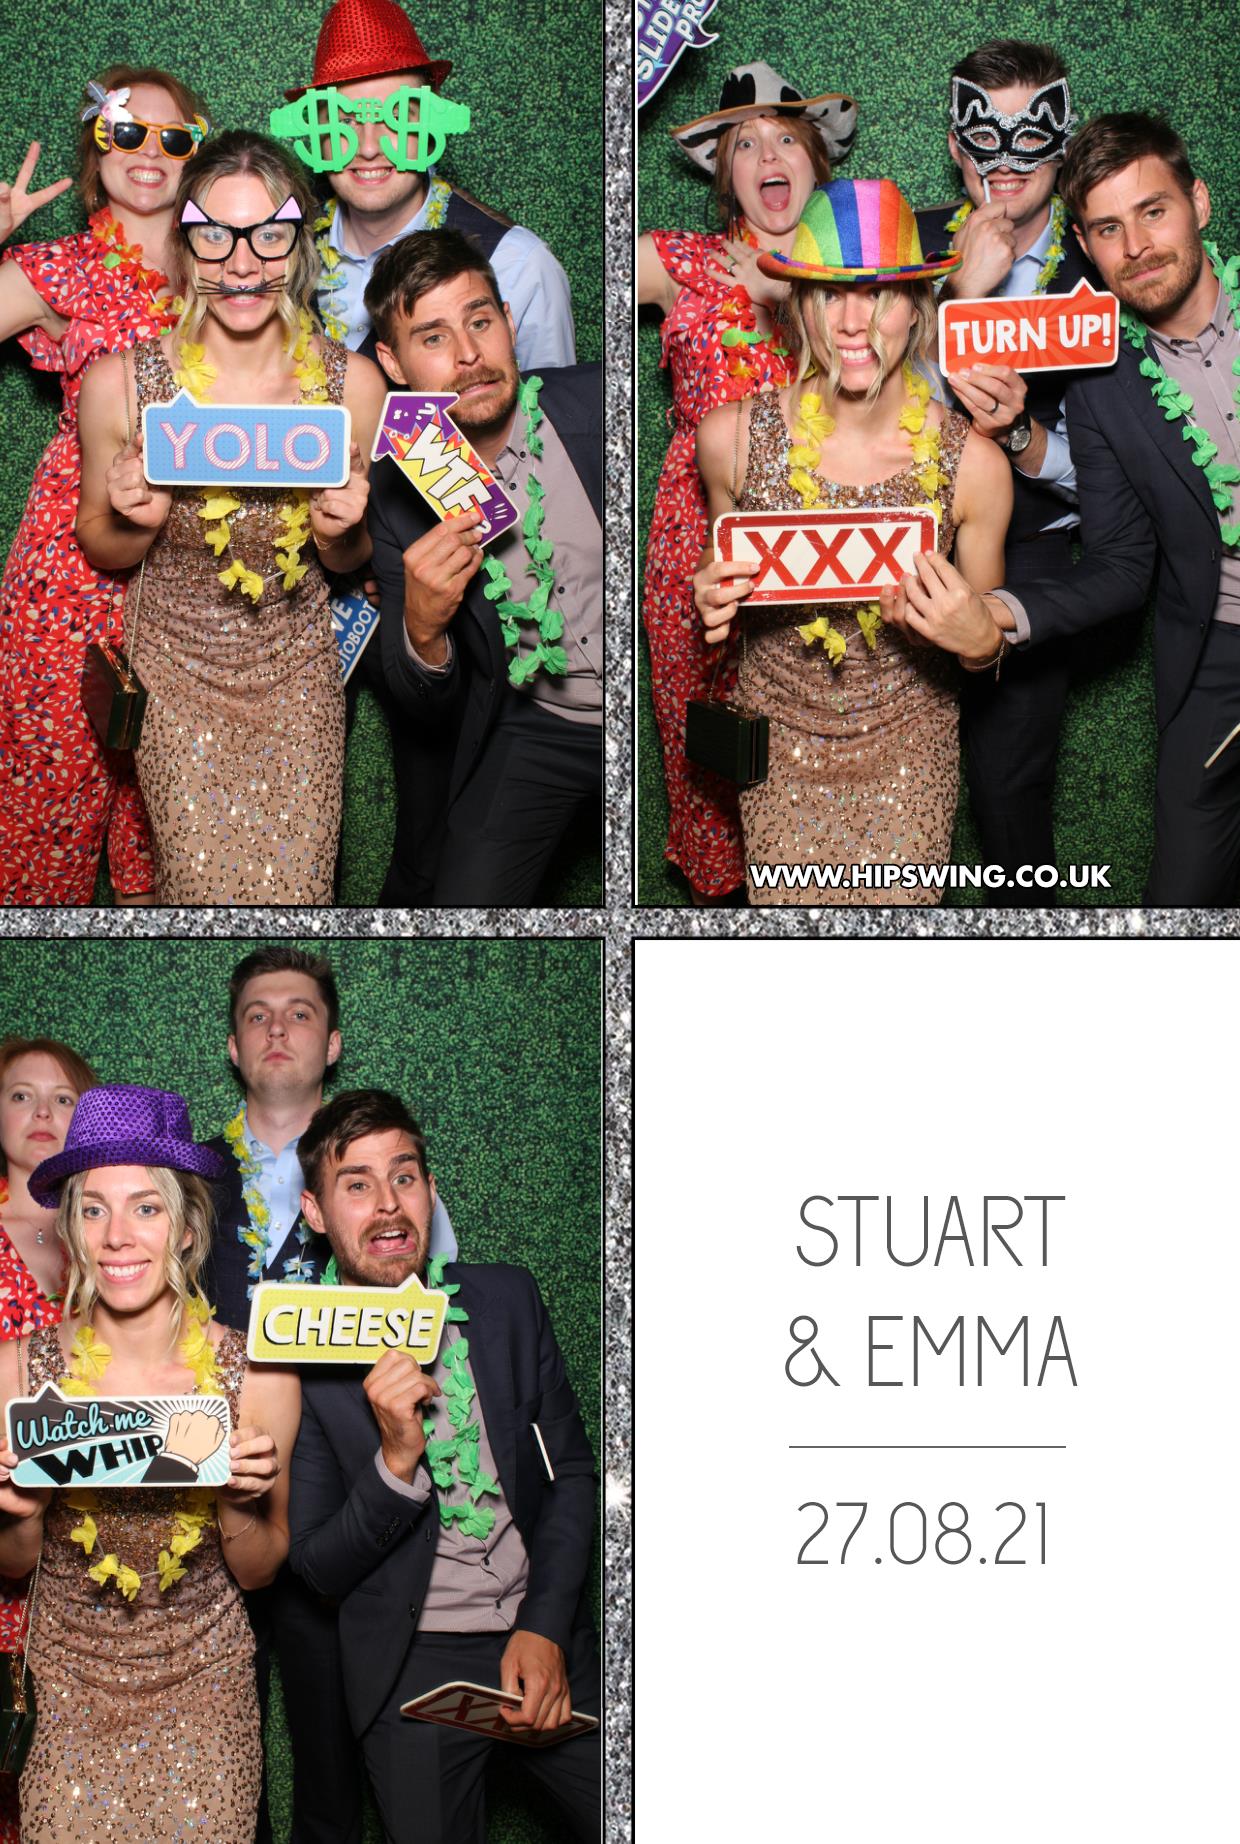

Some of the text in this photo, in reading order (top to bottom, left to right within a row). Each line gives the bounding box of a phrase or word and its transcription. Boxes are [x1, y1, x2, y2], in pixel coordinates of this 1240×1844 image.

[950, 313, 1112, 355] TURN UP!
[159, 422, 331, 471] YOLO
[403, 422, 493, 512] WTF
[743, 527, 911, 586] XXX
[262, 1305, 437, 1349] CHEESE
[16, 1403, 153, 1449] Watch me
[31, 1434, 163, 1485] WHIP
